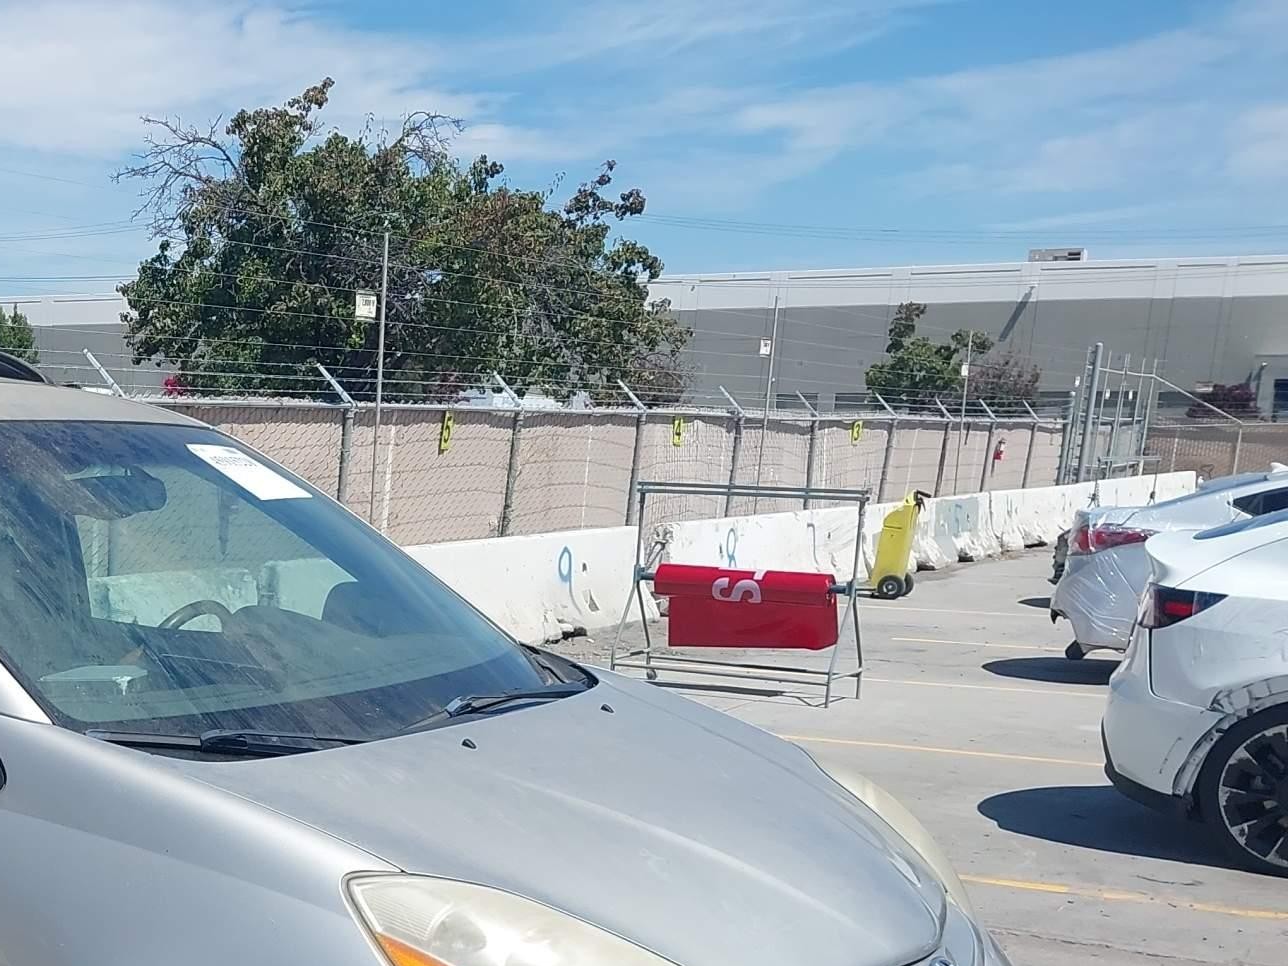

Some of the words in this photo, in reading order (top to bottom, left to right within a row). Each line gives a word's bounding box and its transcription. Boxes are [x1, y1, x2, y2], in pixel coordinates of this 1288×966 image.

[443, 415, 452, 443] 5
[675, 417, 682, 441] 4
[853, 423, 861, 441] 3
[559, 546, 583, 615] 9
